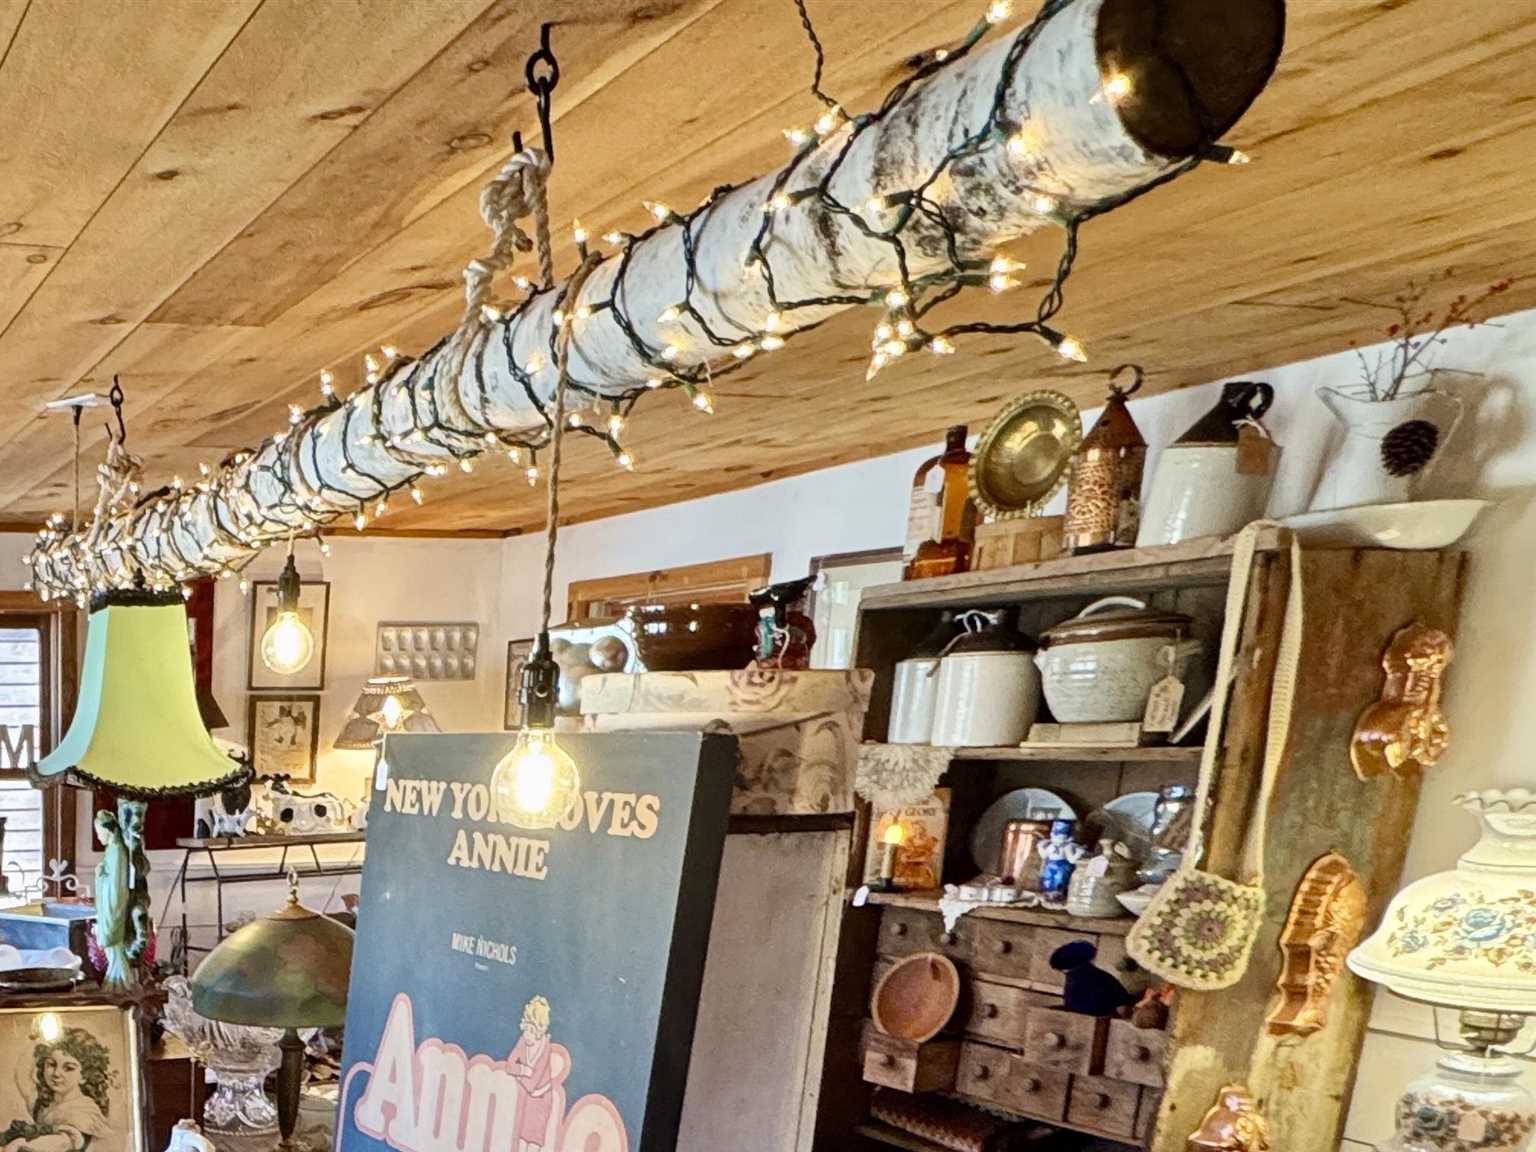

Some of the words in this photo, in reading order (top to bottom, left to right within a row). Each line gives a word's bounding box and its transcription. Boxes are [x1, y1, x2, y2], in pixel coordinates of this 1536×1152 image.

[383, 778, 446, 817] NEW
[450, 782, 526, 825] YOR
[556, 791, 661, 839] OVES
[447, 829, 550, 880] ANNIE
[475, 937, 518, 965] NICHOLS
